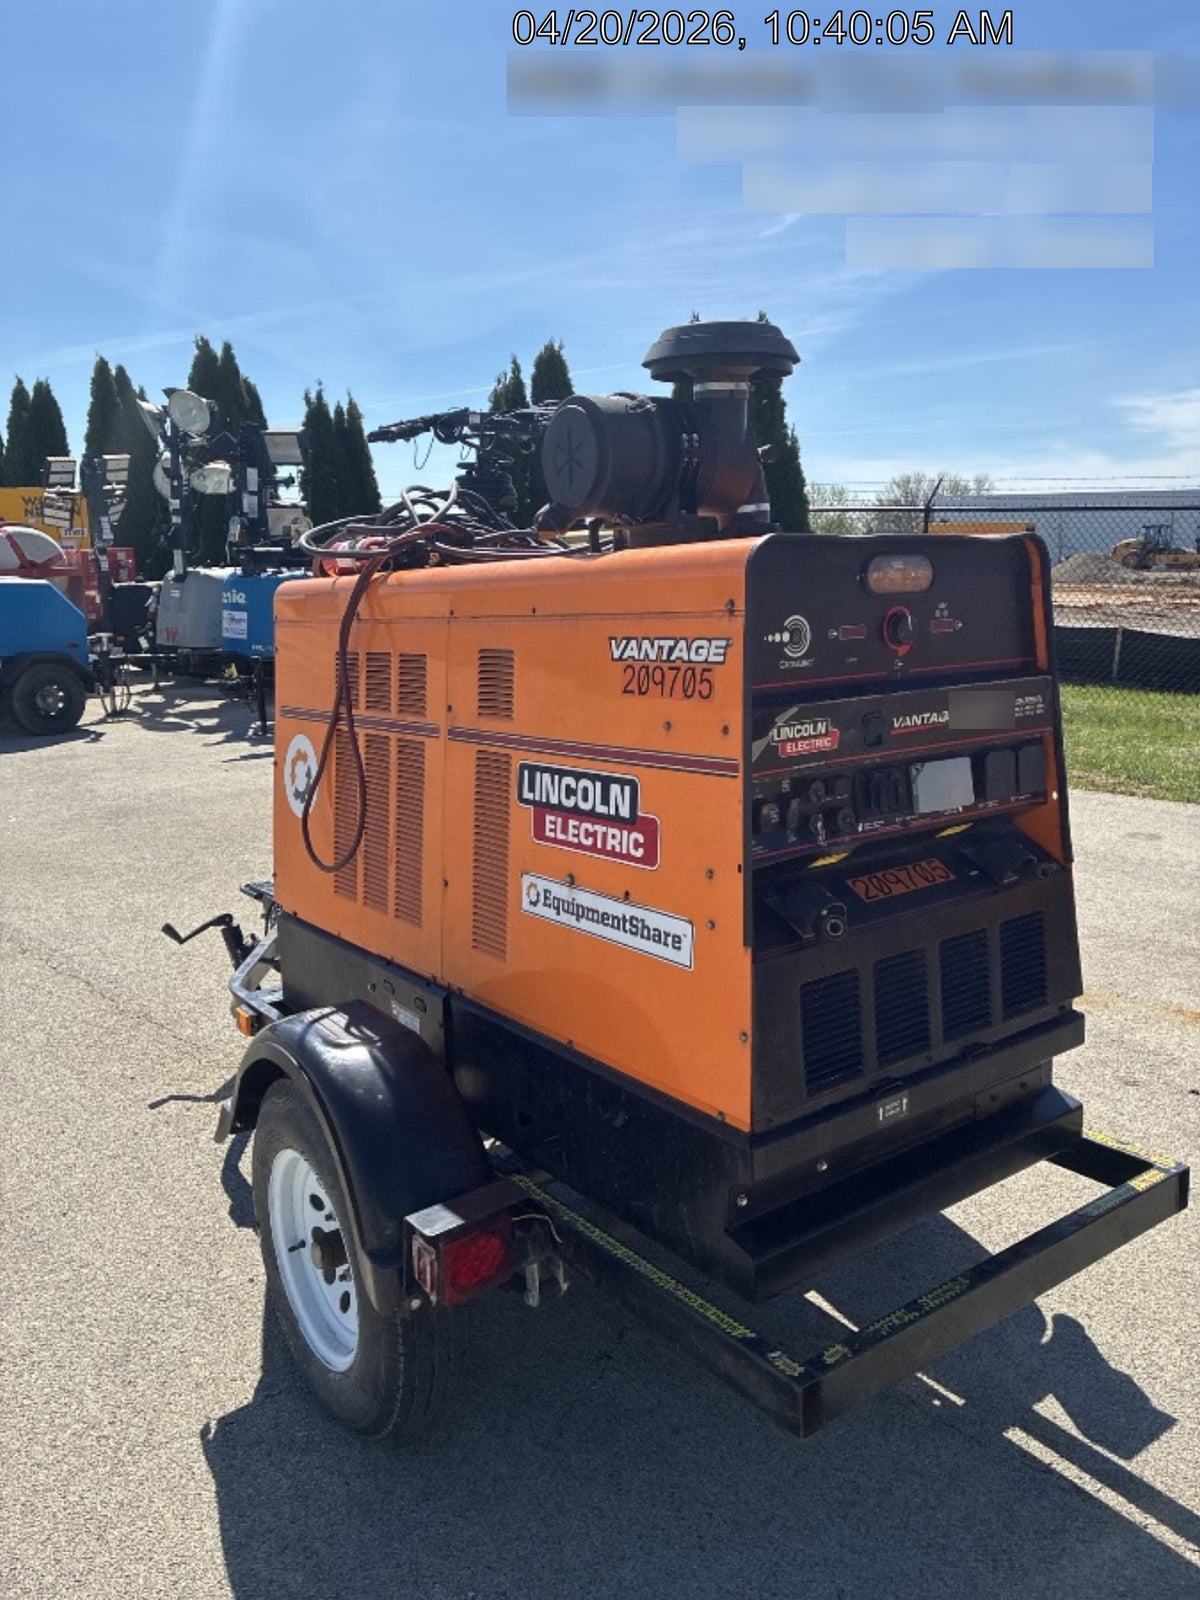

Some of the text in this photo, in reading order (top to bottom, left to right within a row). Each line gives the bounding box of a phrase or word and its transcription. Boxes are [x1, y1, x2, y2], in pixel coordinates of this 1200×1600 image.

[609, 637, 731, 664] VANTAGE
[622, 664, 713, 699] 209705
[773, 721, 827, 741] LINCOLN
[786, 738, 832, 753] ELECTRIC
[522, 769, 631, 819] LINCOLN
[545, 814, 645, 858] ELECTRIC
[852, 859, 951, 900] 209705
[542, 888, 683, 952] EquipmentShare
